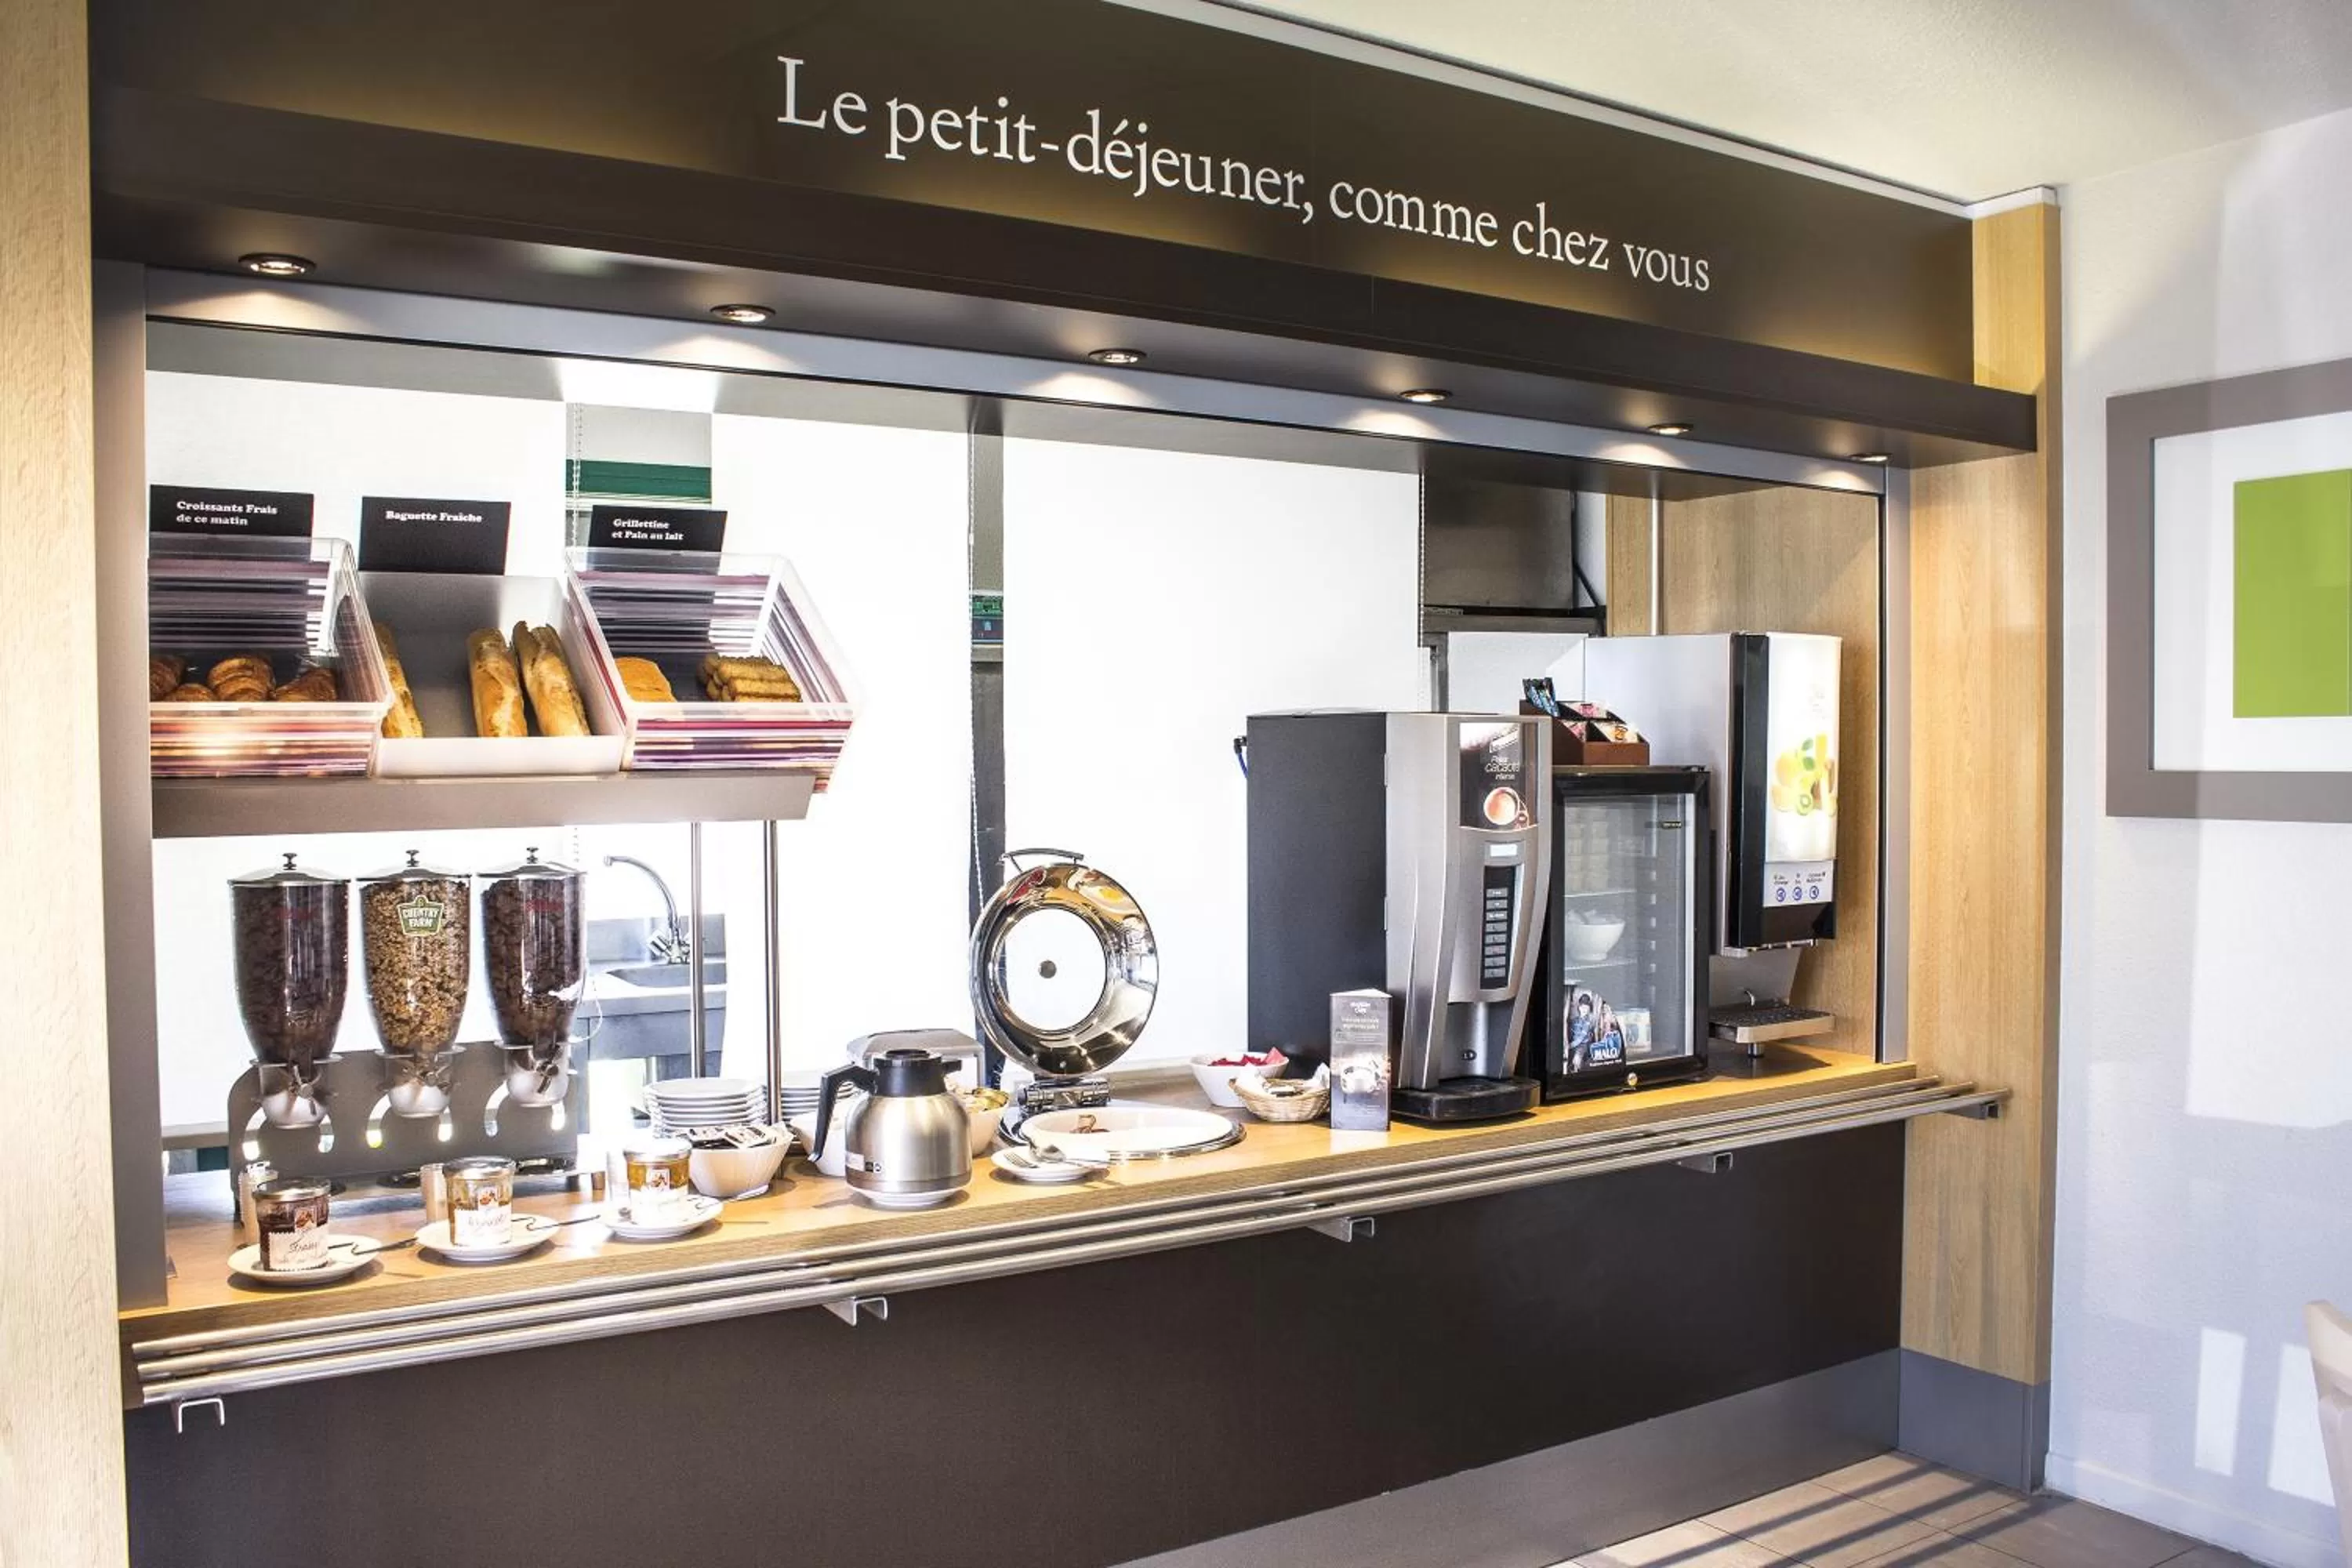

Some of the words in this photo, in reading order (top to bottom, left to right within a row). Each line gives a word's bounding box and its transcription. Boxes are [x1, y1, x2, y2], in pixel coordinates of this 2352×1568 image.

[777, 55, 867, 135] Le
[885, 96, 1315, 224] petit-déjeuner,
[1329, 180, 1498, 248] comme
[1512, 201, 1610, 270] chez
[1622, 240, 1711, 292] vous
[176, 501, 243, 513] Croissants
[245, 504, 278, 515] Frais
[176, 514, 191, 523] de
[210, 515, 249, 526] matin
[385, 510, 437, 522] Baguette
[624, 531, 648, 539] Pain
